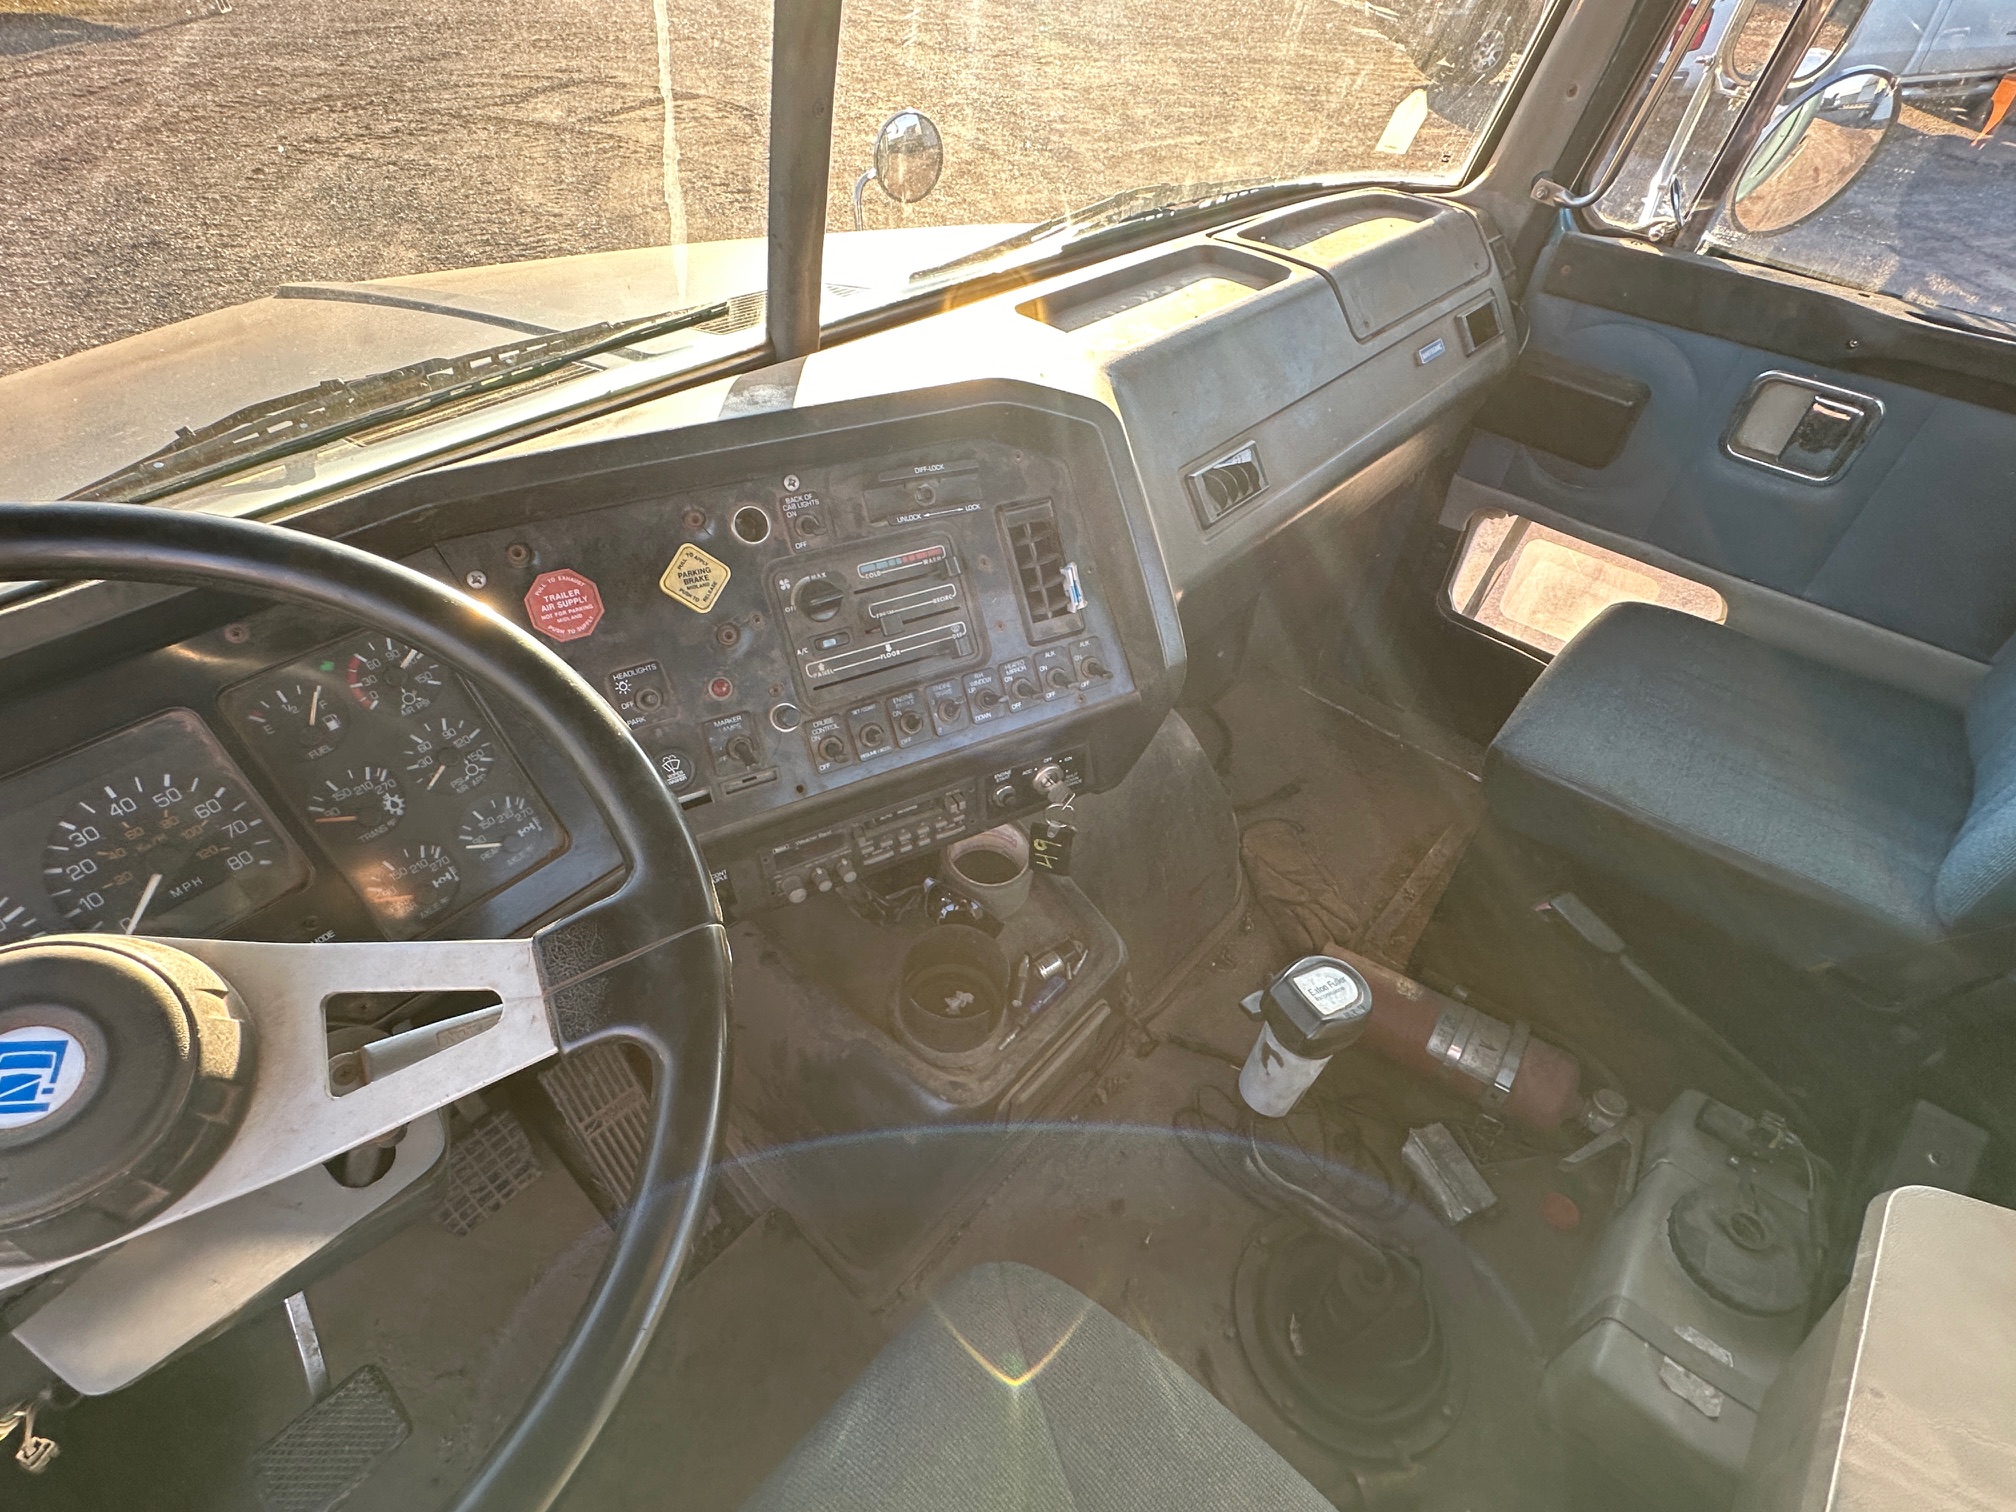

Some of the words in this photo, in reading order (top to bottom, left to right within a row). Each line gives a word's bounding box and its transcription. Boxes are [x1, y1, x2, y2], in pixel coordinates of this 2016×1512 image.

[913, 463, 946, 475] DIFF-LOCK
[782, 503, 797, 512] CAB
[797, 498, 820, 509] LIGHTS
[785, 495, 804, 505] BACK
[786, 510, 798, 519] ON
[896, 513, 922, 524] UNLOCK
[964, 503, 981, 512] LOCK
[794, 540, 808, 550] OFF
[677, 558, 688, 570] PULL
[694, 555, 709, 566] APPLY
[922, 556, 942, 565] WARM
[677, 566, 712, 579] PARKING
[810, 572, 827, 581] MAX
[864, 571, 882, 579] COLD
[534, 583, 547, 596] PULL
[557, 575, 586, 587] EXHAUST
[683, 574, 710, 585] BRAKE
[686, 582, 711, 590] MIDLAND
[543, 588, 581, 603] TRAILER
[678, 587, 692, 598] PUSH
[702, 581, 718, 603] RELEASE
[541, 602, 555, 612] AIR
[557, 595, 588, 609] SUPPLY
[568, 603, 594, 614] PARKING
[547, 625, 565, 634] PUSH
[577, 615, 594, 632] SUPPLY
[557, 613, 583, 623] MIDLAND
[1079, 640, 1091, 648] AUX
[385, 649, 401, 661] 90
[796, 647, 809, 656] A/C
[879, 649, 901, 660] FLOOR
[1045, 650, 1056, 658] AUX
[366, 658, 381, 671] 60
[1004, 659, 1025, 670] HEATED
[1038, 664, 1048, 672] ON
[414, 671, 433, 684] 150
[612, 663, 657, 681] HEADLIGHTS
[812, 668, 834, 679] PANEL
[361, 674, 378, 687] 30
[969, 676, 992, 687] WINDOW
[1080, 679, 1091, 688] OFF
[369, 690, 379, 700] 0
[1045, 690, 1056, 699] OFF
[318, 700, 328, 710] F
[400, 705, 416, 717] AIR
[415, 698, 431, 710] PSI
[620, 701, 635, 710] OFF
[1011, 701, 1022, 710] OFF
[626, 716, 647, 726] PARK
[713, 715, 743, 728] MARKER
[812, 717, 834, 728] CRUISE
[974, 712, 992, 722] DOWN
[263, 724, 276, 735] E
[441, 727, 457, 740] 90
[811, 723, 840, 736] CONTROL
[453, 734, 471, 749] 120
[810, 735, 821, 743] ON
[900, 736, 912, 745] OFF
[308, 744, 335, 760] FUEL
[417, 741, 432, 753] 60
[417, 755, 434, 768] 30
[467, 748, 485, 762] 150
[1043, 756, 1053, 764] OFF
[819, 762, 831, 771] OFF
[353, 780, 374, 796] 210
[374, 778, 397, 795] 270
[152, 787, 184, 809] 50
[331, 787, 352, 802] 150
[109, 797, 138, 818] 40
[194, 798, 223, 820] 60
[514, 806, 534, 822] 270
[160, 815, 181, 830] 80
[478, 816, 496, 831] 150
[496, 810, 515, 824] 210
[124, 826, 145, 841] 60
[180, 824, 204, 840] 100
[219, 819, 250, 839] 70
[357, 824, 388, 843] TRANS
[67, 826, 101, 848] 30
[196, 844, 220, 860] 120
[226, 850, 254, 872] 80
[409, 858, 429, 875] 210
[429, 855, 451, 872] 270
[65, 858, 98, 882] 20
[389, 866, 408, 881] 150
[169, 876, 203, 899] MPH
[78, 892, 106, 911] 10
